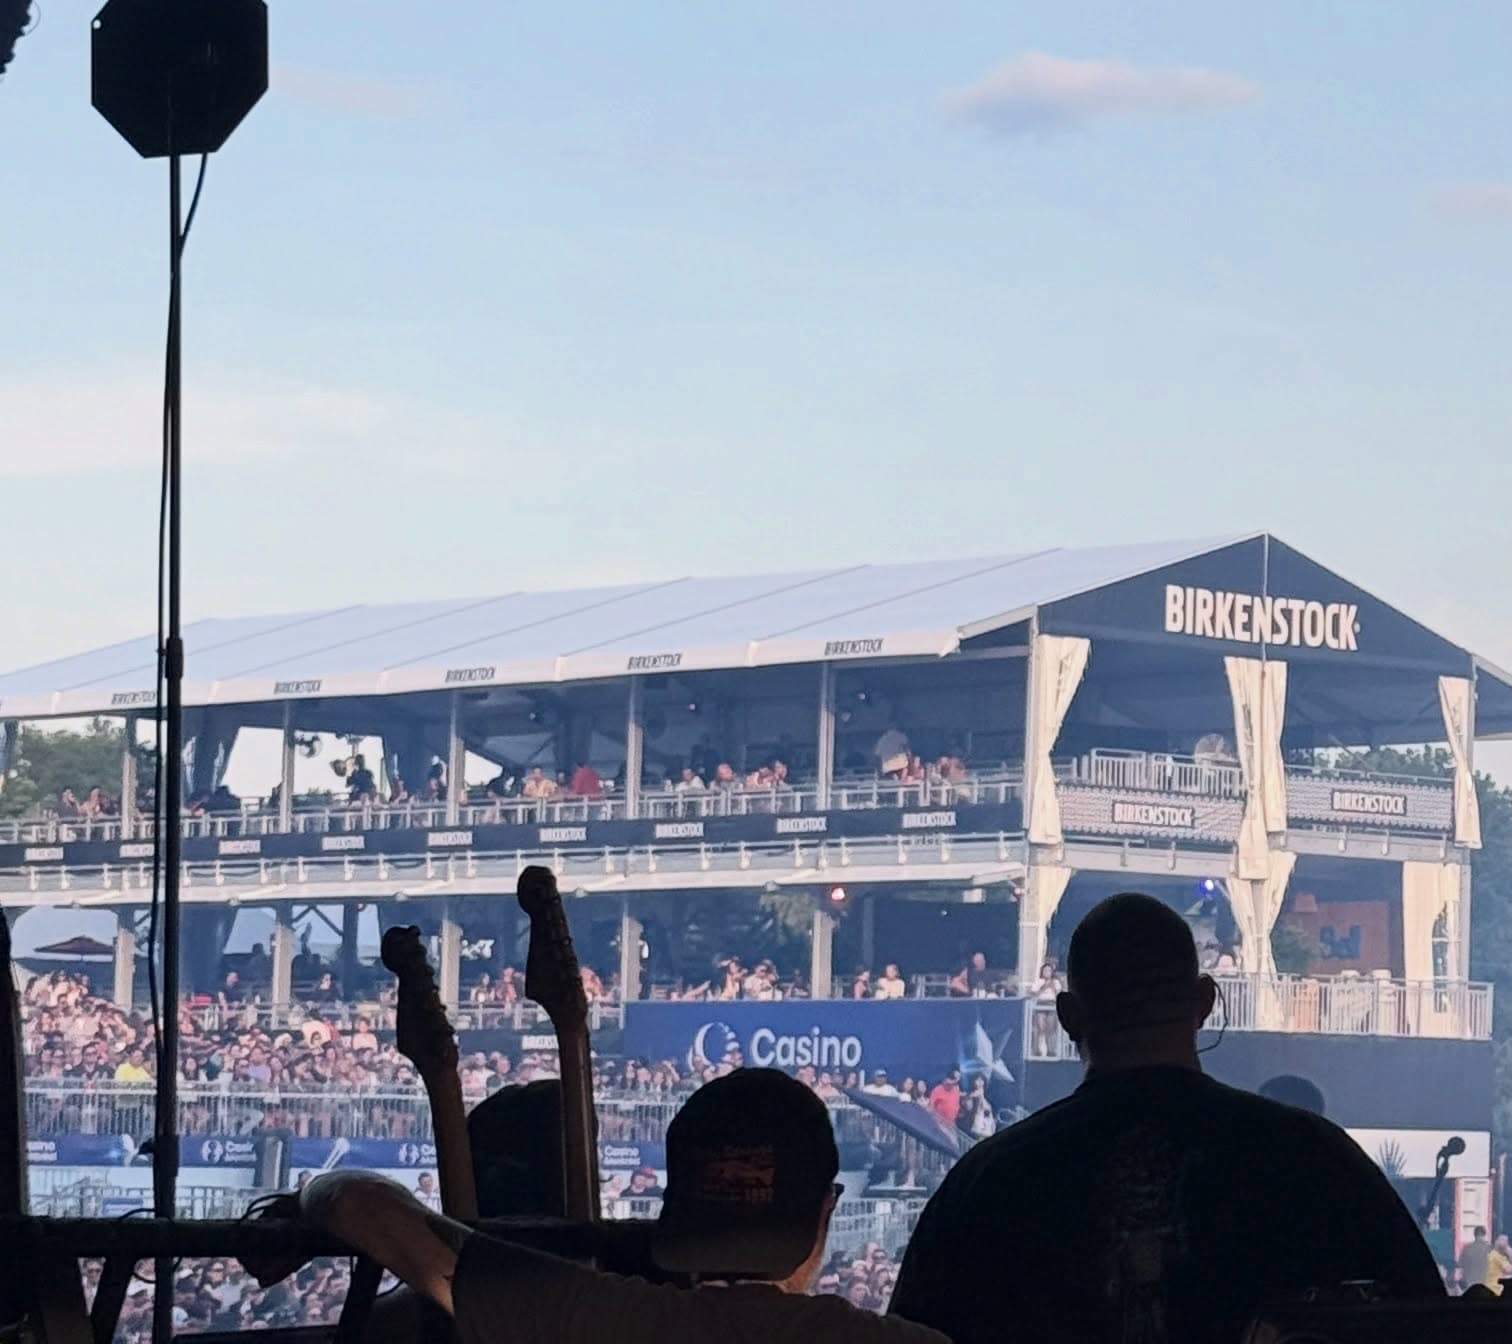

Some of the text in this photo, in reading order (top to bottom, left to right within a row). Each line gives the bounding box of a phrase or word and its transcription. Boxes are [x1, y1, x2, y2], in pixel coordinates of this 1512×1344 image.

[1164, 584, 1359, 651] BIRKENSTOCK
[1113, 802, 1195, 827] BIRKENSTOCK
[1332, 791, 1405, 814] BIRKENSTOCK
[750, 1025, 862, 1068] Casino
